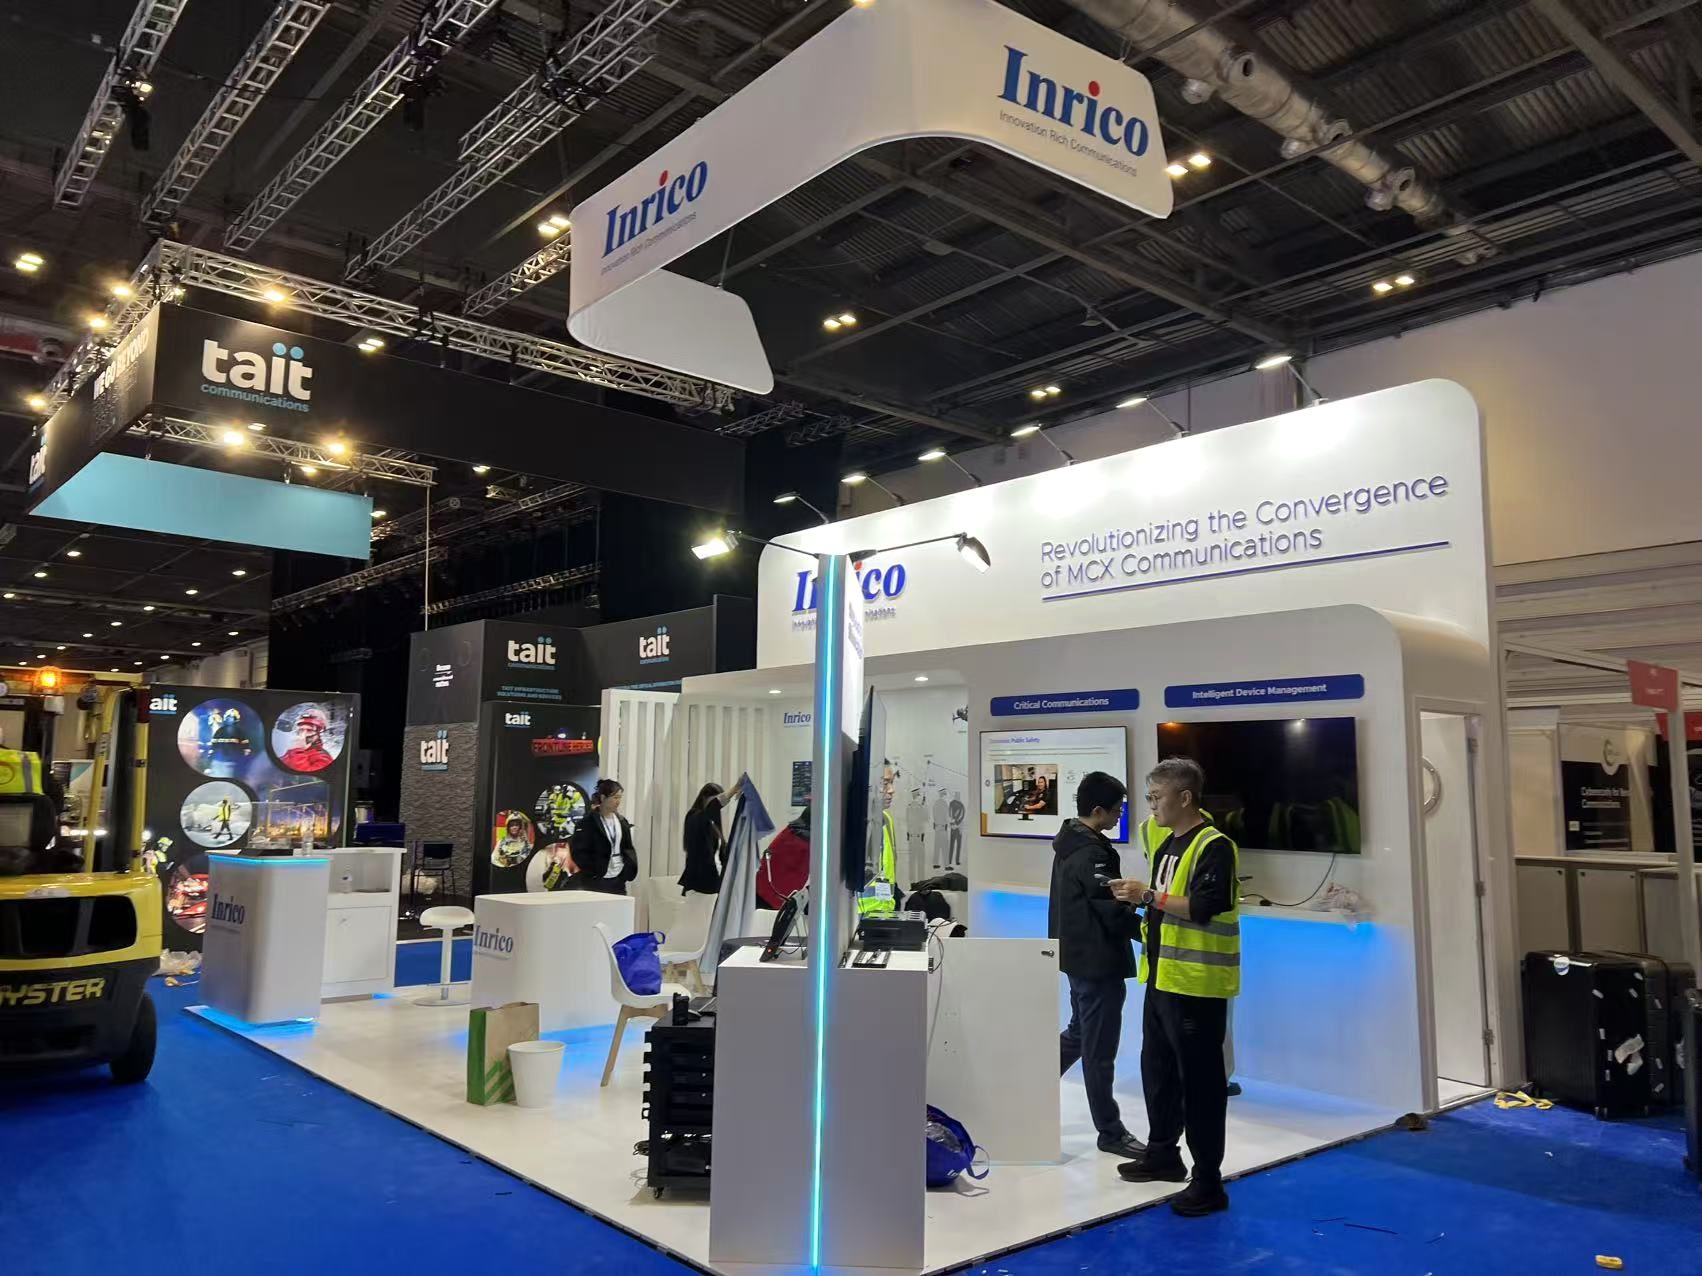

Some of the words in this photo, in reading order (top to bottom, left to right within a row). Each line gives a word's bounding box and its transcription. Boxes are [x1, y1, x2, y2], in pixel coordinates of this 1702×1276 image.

[997, 44, 1149, 157] Inrico
[1000, 110, 1048, 138] Innovation
[1050, 129, 1069, 148] Rich
[602, 160, 708, 259] Inrico
[202, 339, 313, 401] tait
[200, 384, 310, 413] communications
[1041, 516, 1200, 564] Revolutionizing
[1207, 509, 1247, 533] the
[1256, 475, 1449, 526] Convergence
[1040, 565, 1061, 588] of
[1067, 557, 1115, 585] MCX
[1120, 528, 1323, 577] Communications
[507, 636, 557, 665] tait
[639, 626, 670, 658] tait
[149, 693, 178, 711] ait
[1013, 700, 1041, 710] Critical
[1041, 697, 1110, 709] Communications
[1192, 689, 1234, 700] Intelligent
[1235, 687, 1266, 697] Device
[1267, 683, 1328, 695] Management
[505, 711, 531, 725] tait
[783, 711, 811, 724] Inrico
[420, 730, 449, 764] tait
[474, 925, 514, 953] Inrico
